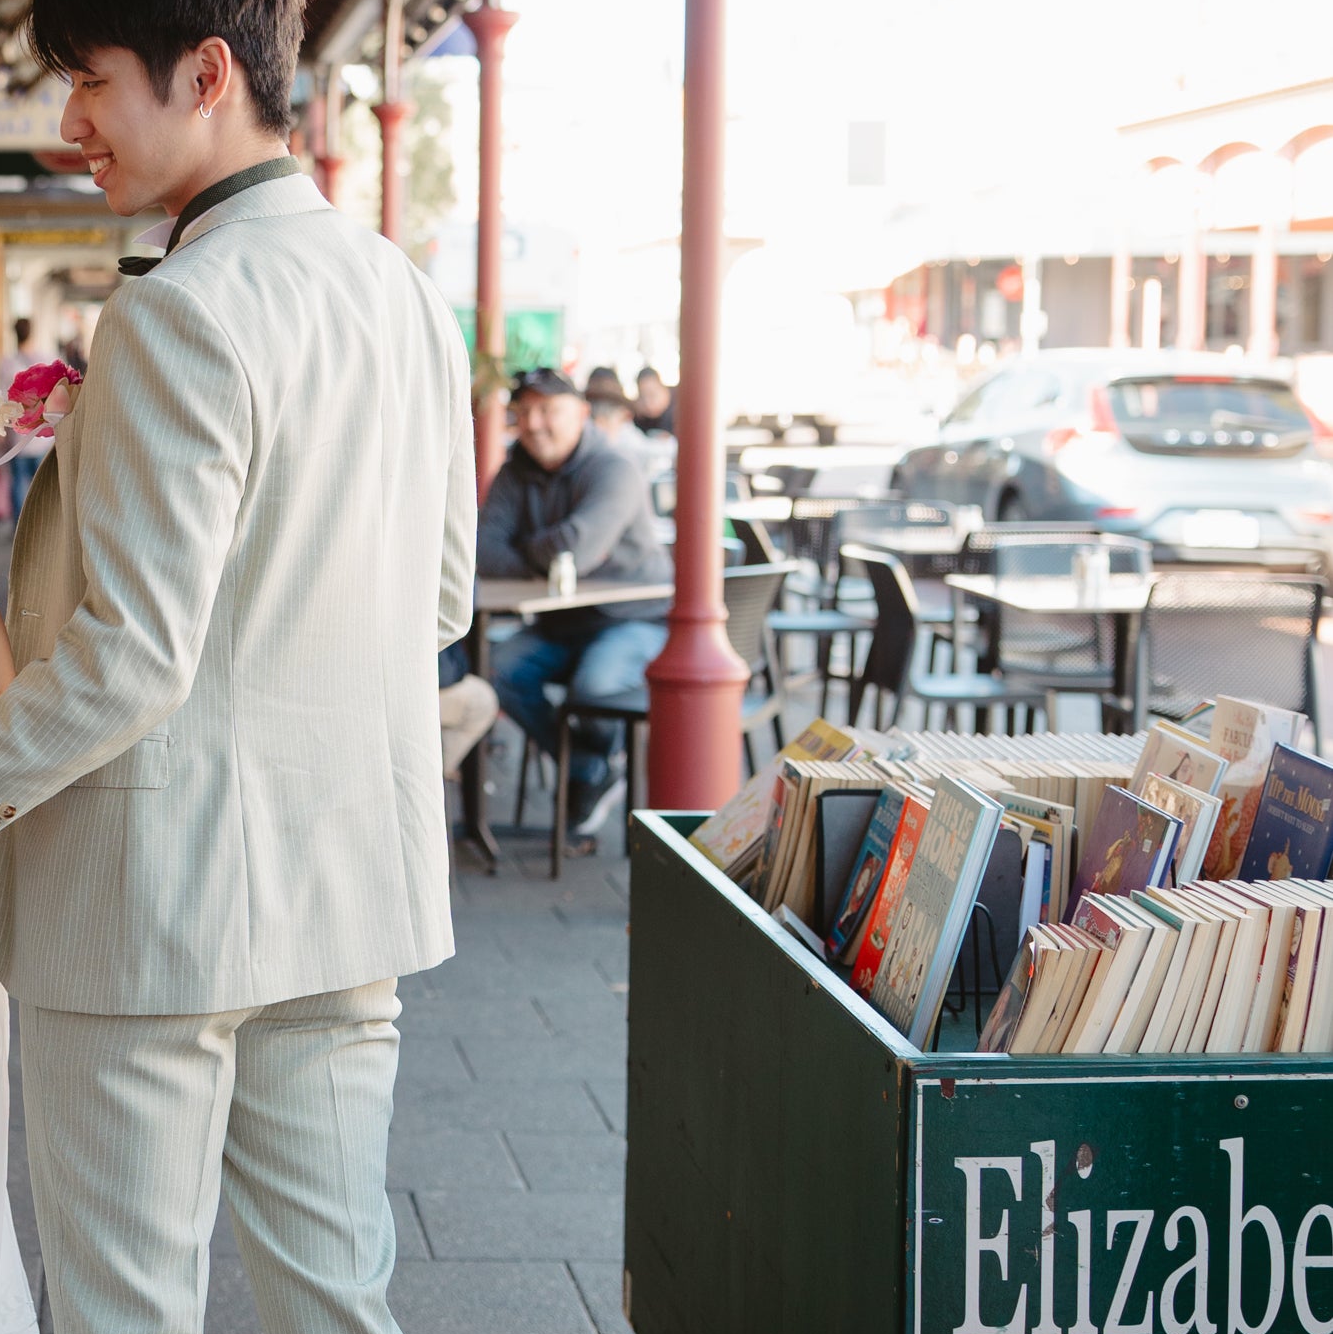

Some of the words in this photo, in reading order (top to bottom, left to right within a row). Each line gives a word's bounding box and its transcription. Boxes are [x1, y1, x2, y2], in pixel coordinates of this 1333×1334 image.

[934, 790, 962, 827] THIS
[959, 804, 975, 838] IS
[918, 820, 966, 883] HOME
